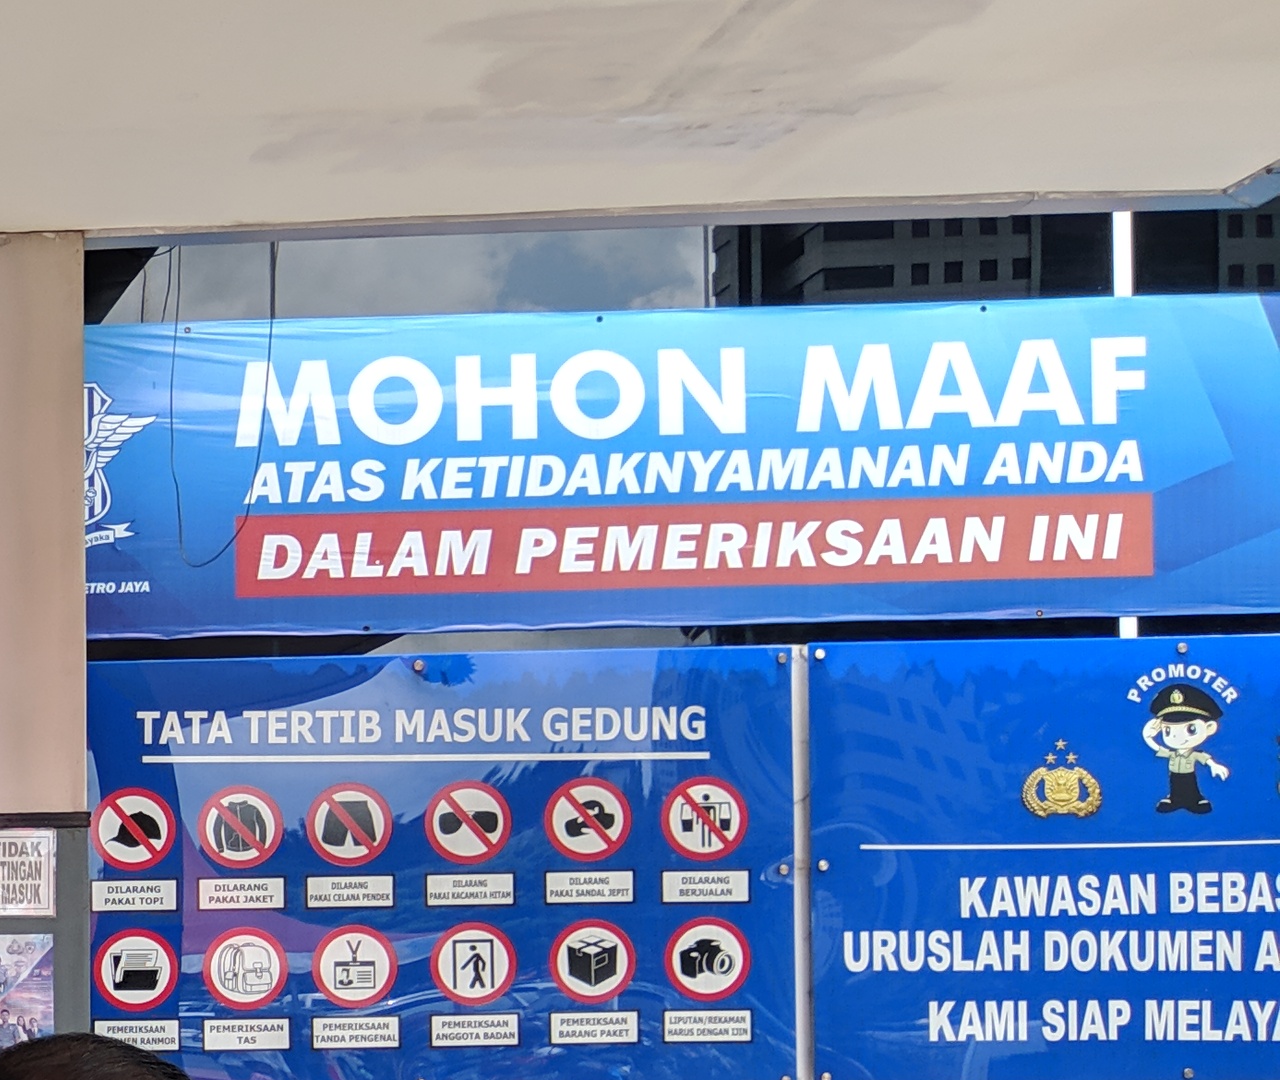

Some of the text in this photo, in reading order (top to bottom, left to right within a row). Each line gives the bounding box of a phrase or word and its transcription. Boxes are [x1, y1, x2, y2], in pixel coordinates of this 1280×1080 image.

[234, 336, 1147, 448] MOHON MAAF
[243, 439, 1145, 505] ATAS KETIDAKNYAMANAN ANDA
[255, 512, 1125, 581] DALAM PEMERIKSAAN INI
[85, 581, 151, 594] ETRO JAYA
[1125, 662, 1238, 704] PROMOTER
[136, 705, 706, 745] TATA TERTIB MASUK GEDUNG
[330, 881, 369, 890] DILARANG
[452, 879, 488, 888] DILARANG
[568, 876, 610, 886] DILARANG
[681, 876, 730, 885] DILARANG
[107, 885, 161, 894] DILARANG
[214, 883, 269, 893] DILARANG
[549, 888, 630, 898] PAKAI SANDAL JEPIT
[678, 888, 733, 897] BERJUALAN
[1, 883, 41, 905] MASUK
[309, 892, 391, 902] PAKAI CELANA PENDEK
[429, 891, 450, 900] PAKAI
[959, 871, 1280, 919] KAWASAN BEBA
[104, 897, 164, 906] PAKAI TOPI
[208, 895, 275, 904] PAKAI JAKET
[843, 929, 1030, 973] URUSLAH
[1044, 929, 1242, 972] DOKUMEN
[441, 1019, 509, 1029] PEMERIKSAAN
[559, 1017, 628, 1027] PEMERIKSAAN
[928, 1000, 1028, 1042] KAMI
[1041, 1000, 1131, 1042] SIAP
[106, 1025, 166, 1034] PEMERIKSAAN
[209, 1024, 284, 1034] PEMERIKSAAN
[322, 1022, 390, 1031] PEMERIKSAAN
[435, 1031, 516, 1041] ANGGOTA BADAN
[558, 1029, 630, 1038] BARANG PAKET
[696, 1028, 729, 1036] DENGAN
[139, 1036, 176, 1046] RANMOR
[237, 1036, 257, 1045] TAS
[315, 1034, 398, 1043] TANDA PENGENAL
